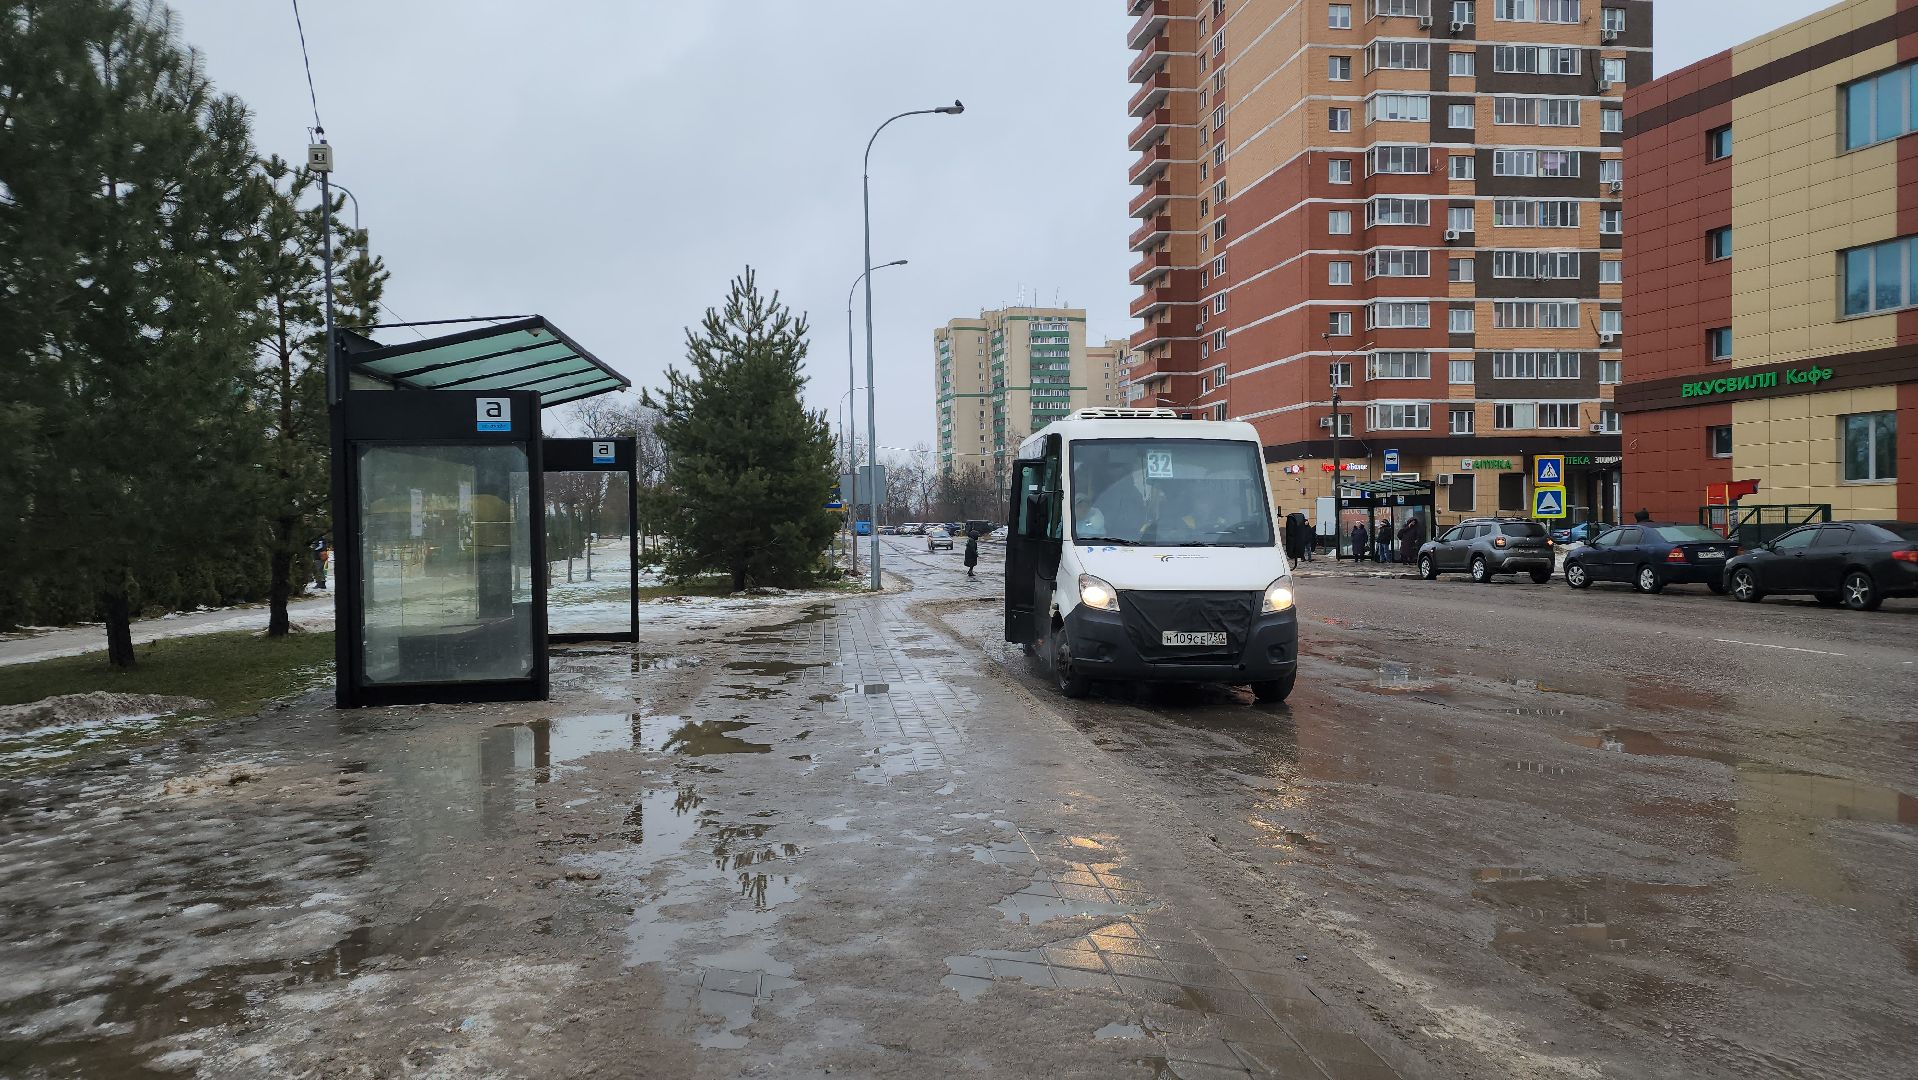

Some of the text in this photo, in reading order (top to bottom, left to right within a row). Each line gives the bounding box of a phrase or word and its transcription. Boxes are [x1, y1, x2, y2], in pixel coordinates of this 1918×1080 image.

[1681, 364, 1834, 398] ВКУСВИЛЛ Кафе
[1148, 454, 1171, 473] 32
